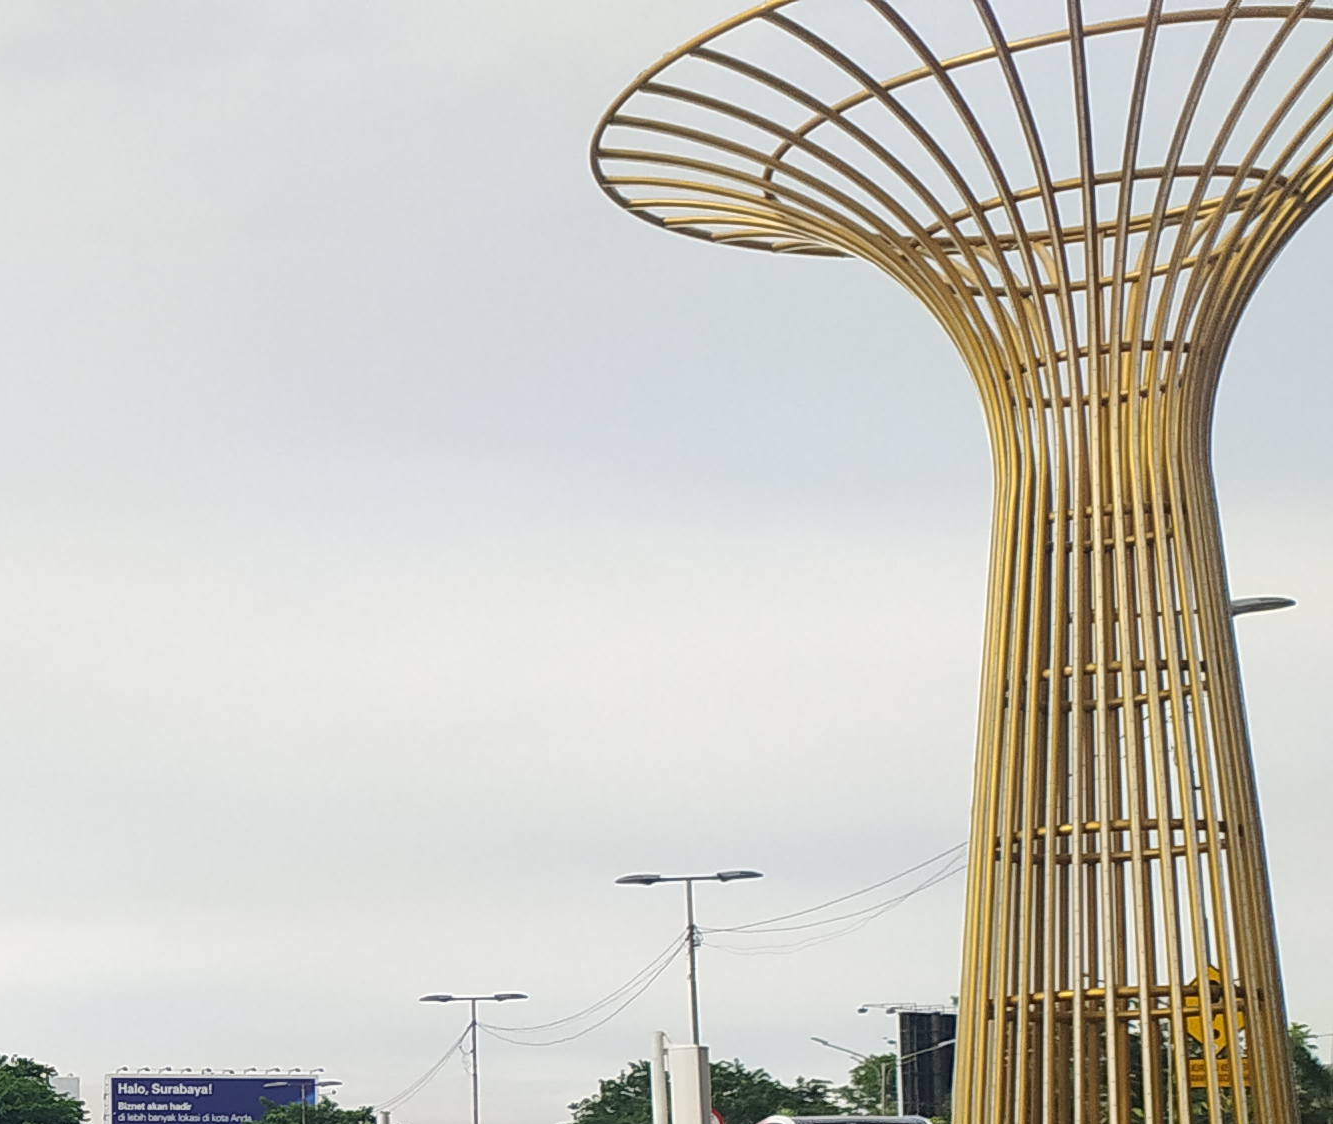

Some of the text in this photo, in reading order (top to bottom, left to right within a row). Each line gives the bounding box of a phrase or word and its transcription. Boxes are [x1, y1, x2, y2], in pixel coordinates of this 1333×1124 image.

[118, 1082, 213, 1097] Halo, Surabaya!
[117, 1102, 193, 1111] Biznet akan hadir
[117, 1113, 125, 1122] di
[127, 1113, 147, 1122] lebih
[148, 1113, 176, 1123] banyak
[178, 1113, 200, 1122] lokasi
[202, 1113, 210, 1122] di
[211, 1113, 229, 1122] kota
